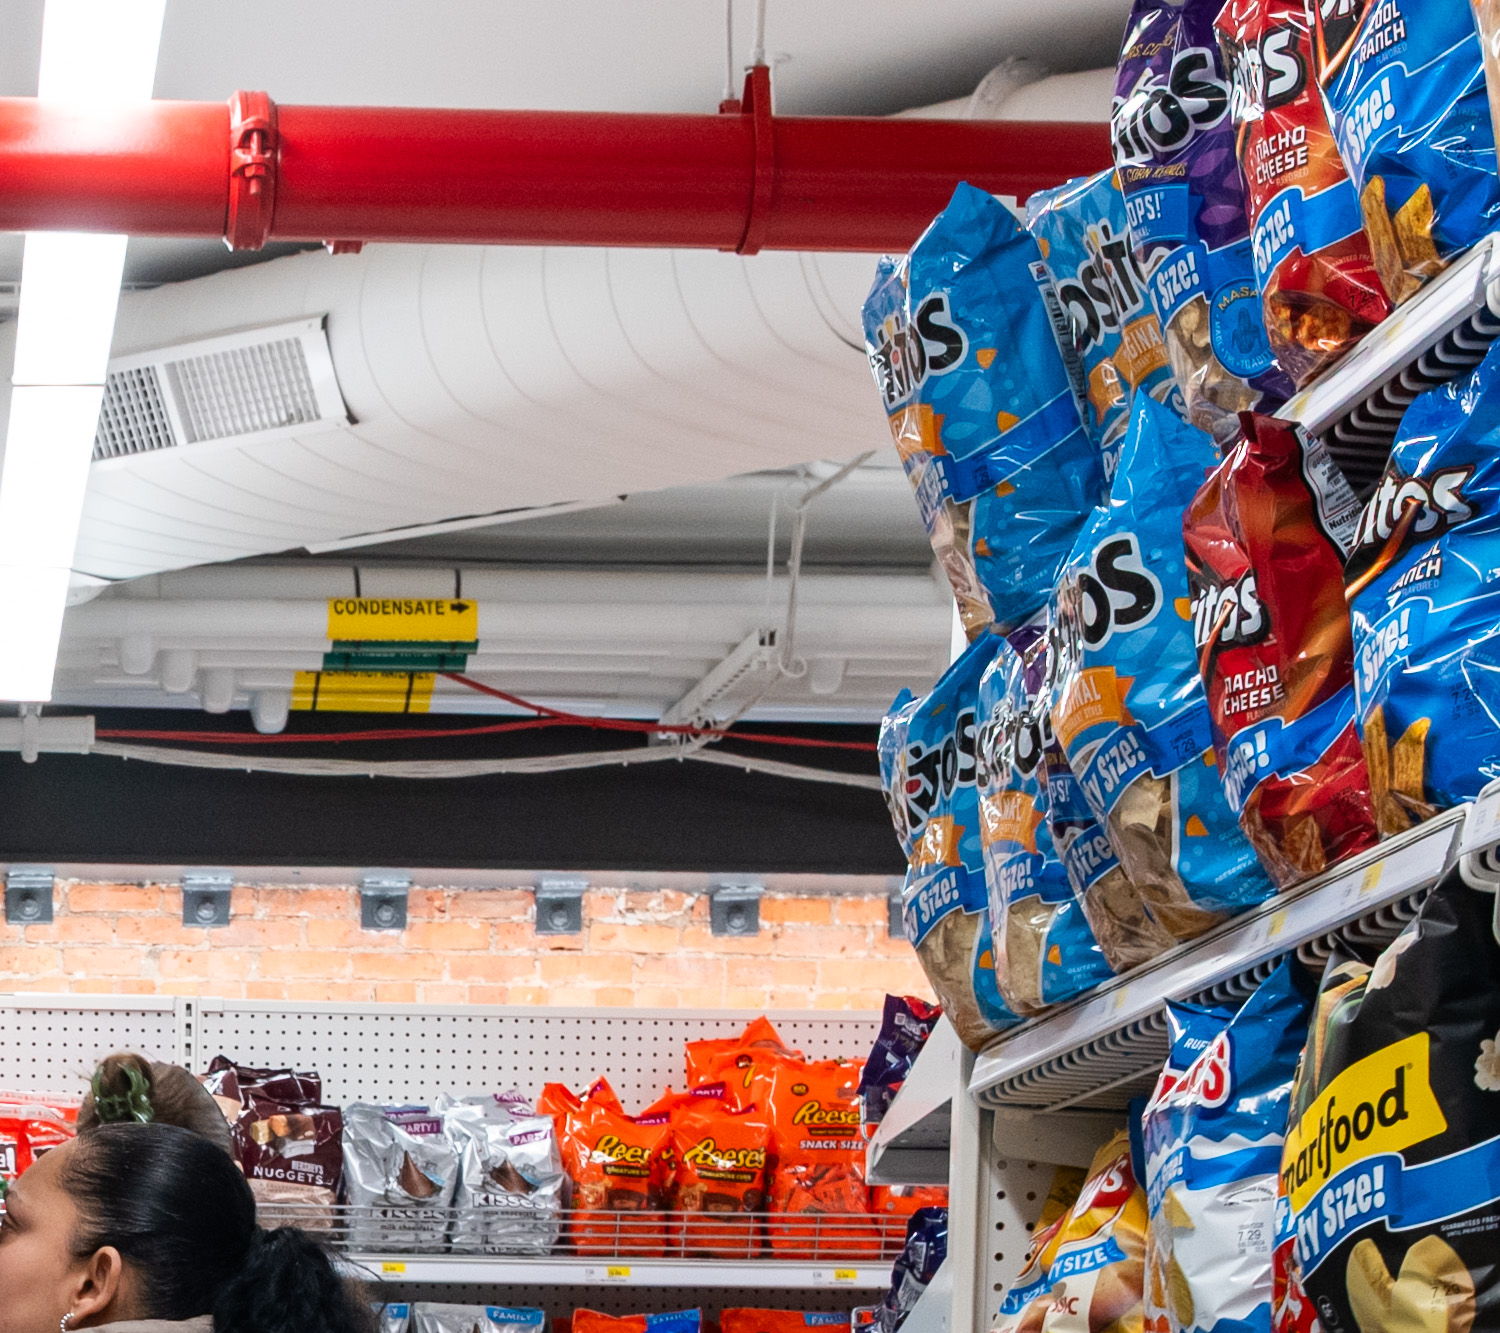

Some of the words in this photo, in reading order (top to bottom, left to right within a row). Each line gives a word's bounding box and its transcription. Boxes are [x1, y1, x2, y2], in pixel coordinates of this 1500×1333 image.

[1359, 18, 1406, 65] RANCH
[1255, 126, 1307, 156] NACHO
[1256, 146, 1309, 184] CHEESE
[334, 600, 446, 616] CONDENSATE
[1222, 664, 1282, 699] NACHO
[1222, 684, 1286, 718] CHEESE
[793, 1102, 859, 1126] Reese
[1282, 1064, 1411, 1195] martfood
[800, 1140, 836, 1149] SNACK
[253, 1165, 324, 1186] NUGGETS
[1322, 1164, 1388, 1232] Size!
[493, 1312, 533, 1322] FAMILY
